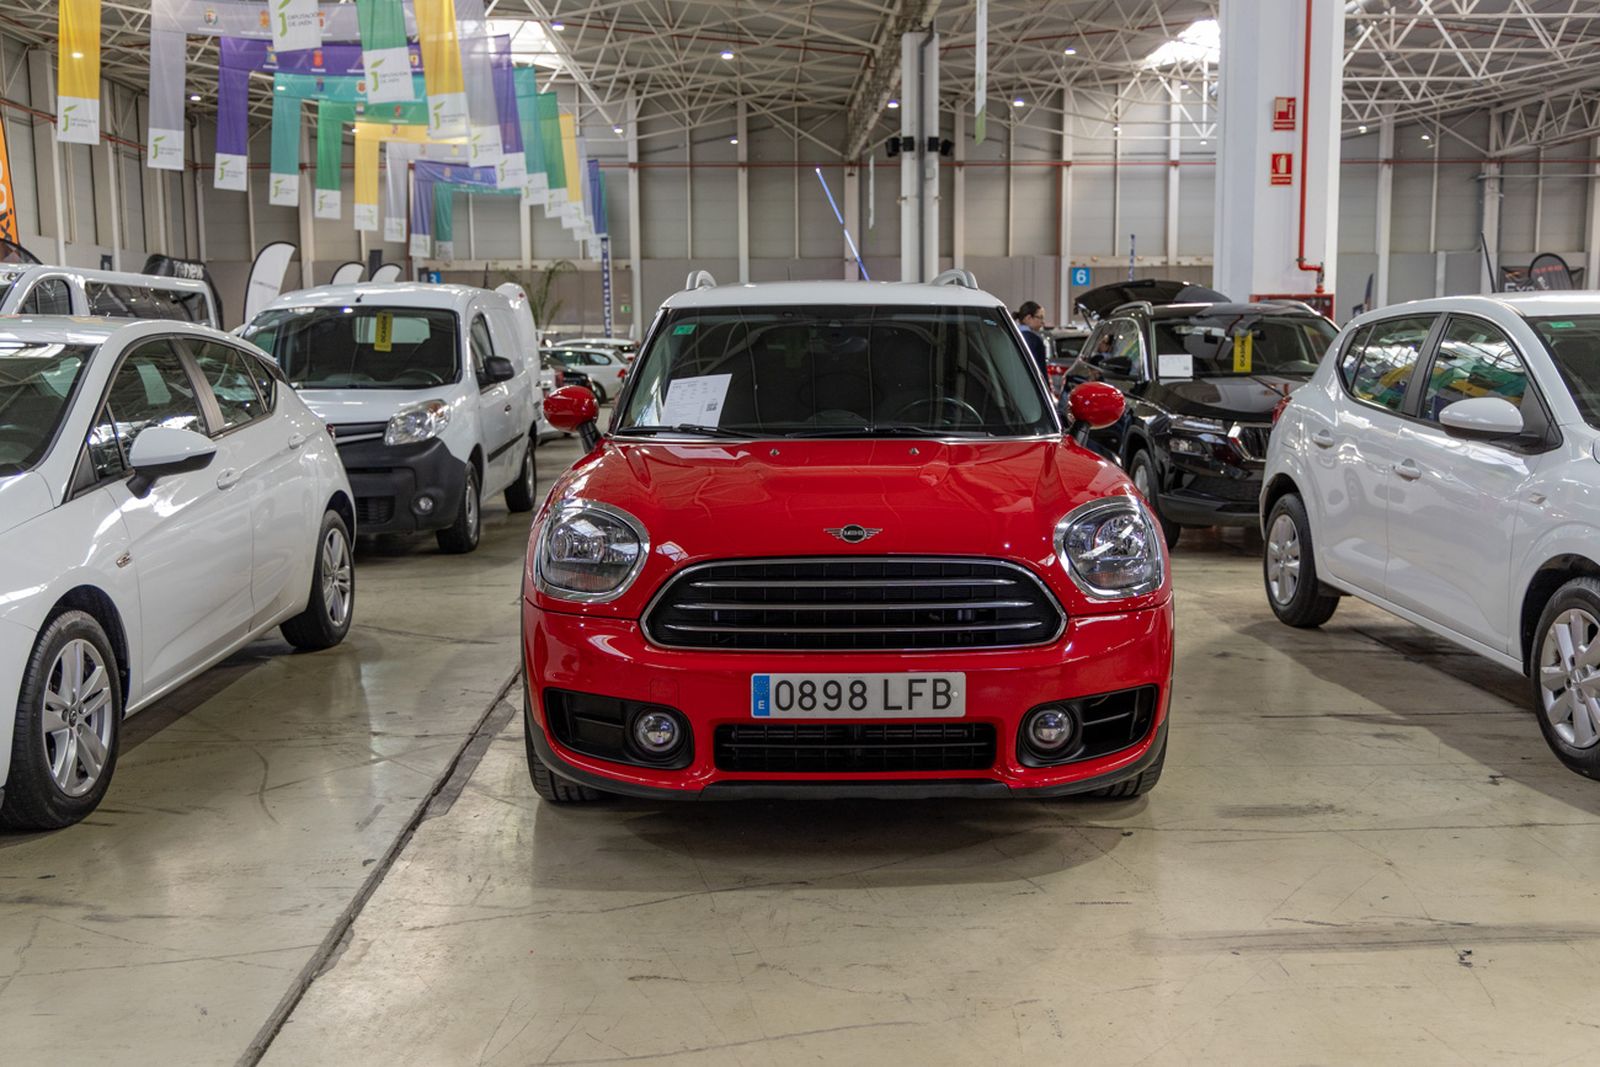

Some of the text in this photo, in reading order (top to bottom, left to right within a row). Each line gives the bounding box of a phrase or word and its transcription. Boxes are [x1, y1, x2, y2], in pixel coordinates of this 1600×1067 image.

[1076, 269, 1087, 284] 6
[775, 678, 952, 711] 0898 LFB
[758, 700, 765, 710] E
